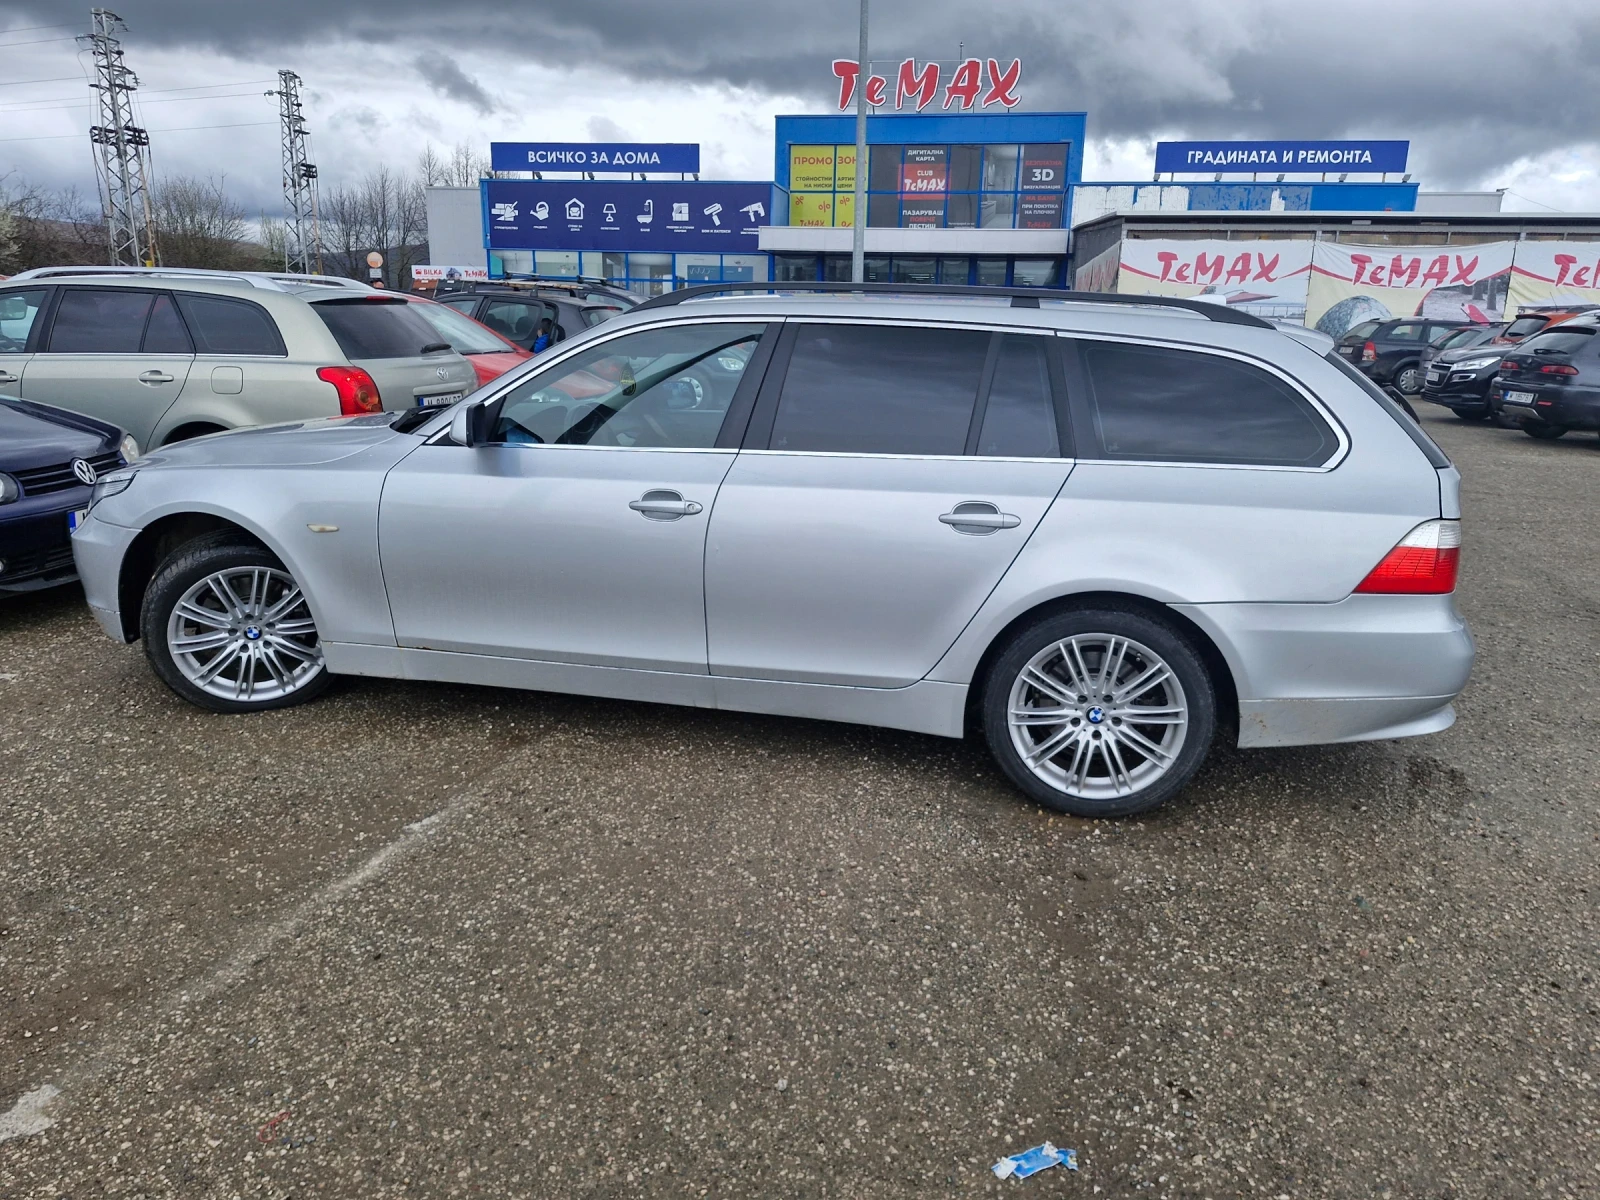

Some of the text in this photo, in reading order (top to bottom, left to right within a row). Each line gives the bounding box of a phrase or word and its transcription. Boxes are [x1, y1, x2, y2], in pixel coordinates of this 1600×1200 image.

[832, 58, 1021, 111] TeMAX
[527, 151, 661, 166] ВСИЧКО ЗА ДОМА
[793, 156, 868, 165] ПРОМО ЗОН
[1187, 150, 1373, 166] ГРАДИНАТА И РЕМОНТА
[1031, 168, 1055, 182] 3D
[904, 178, 946, 192] TeMAX
[423, 268, 443, 276] BILKA
[1157, 251, 1280, 285] TeMAX
[1350, 253, 1479, 288] TeMAX
